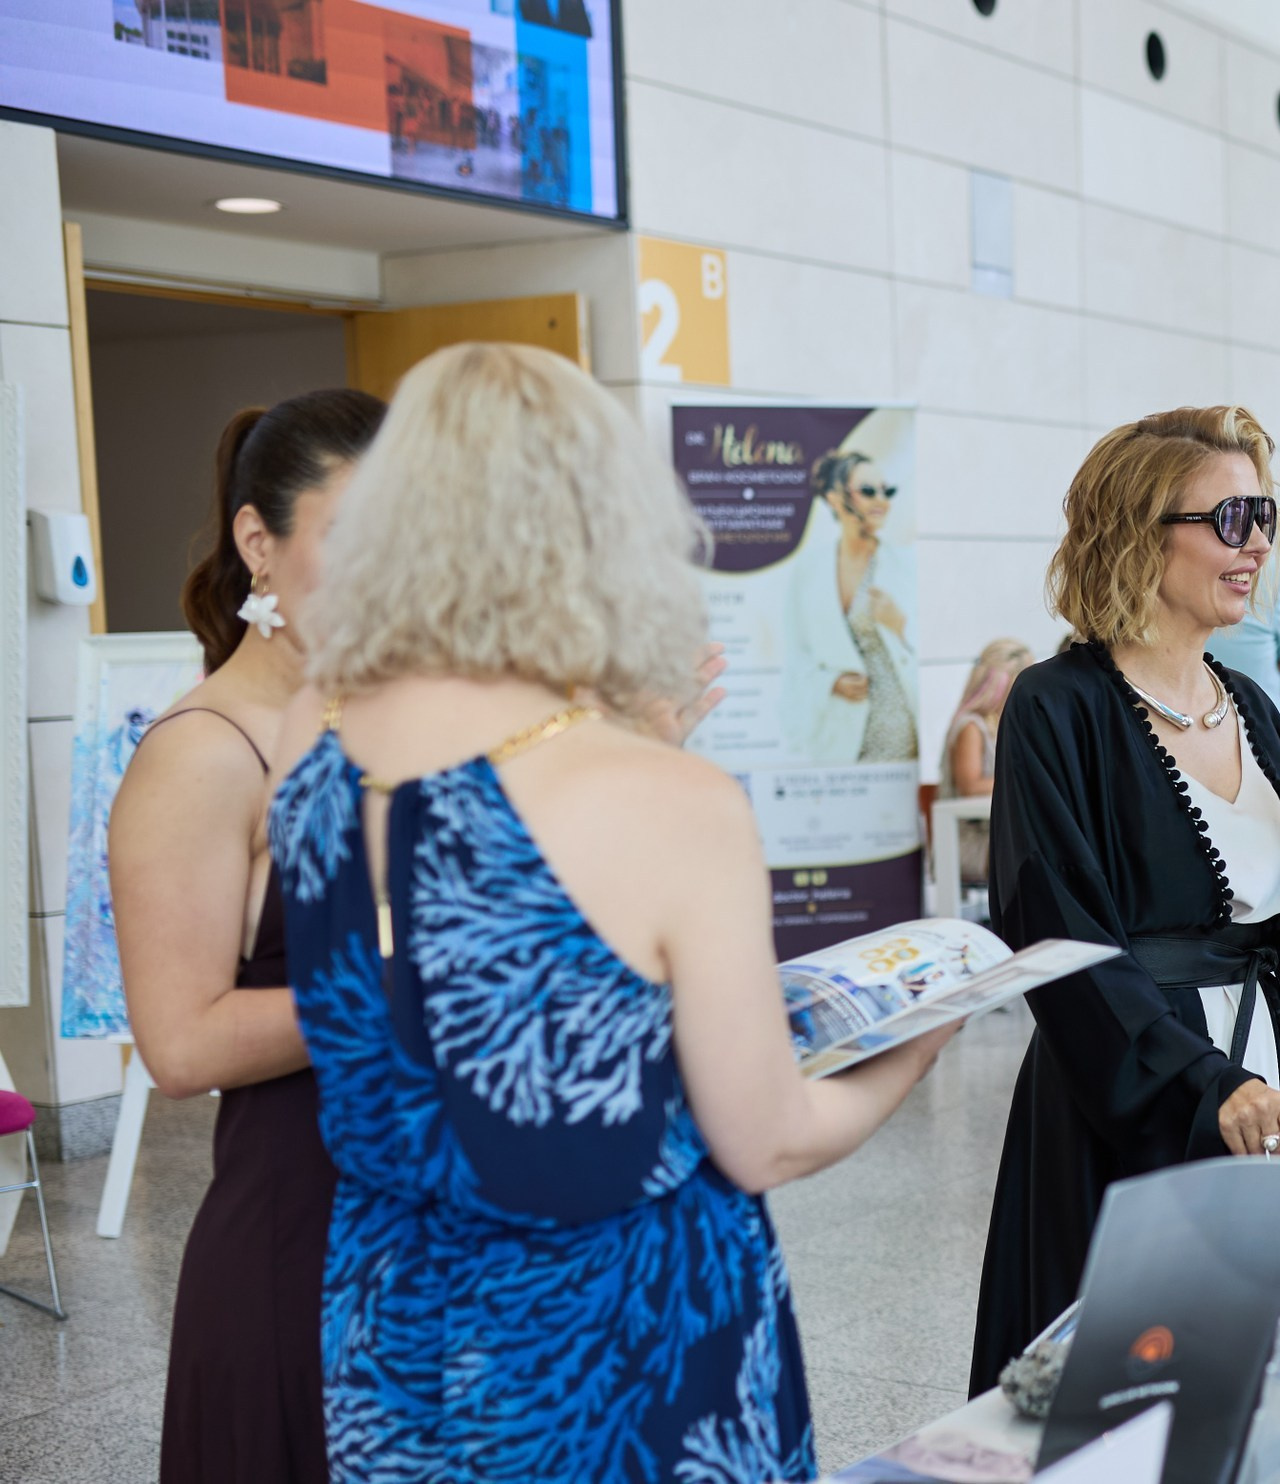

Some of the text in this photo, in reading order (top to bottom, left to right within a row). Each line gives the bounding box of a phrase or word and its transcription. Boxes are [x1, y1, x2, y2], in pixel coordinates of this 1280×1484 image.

[701, 252, 724, 300] B
[639, 278, 683, 385] 2
[708, 422, 804, 468] Helena
